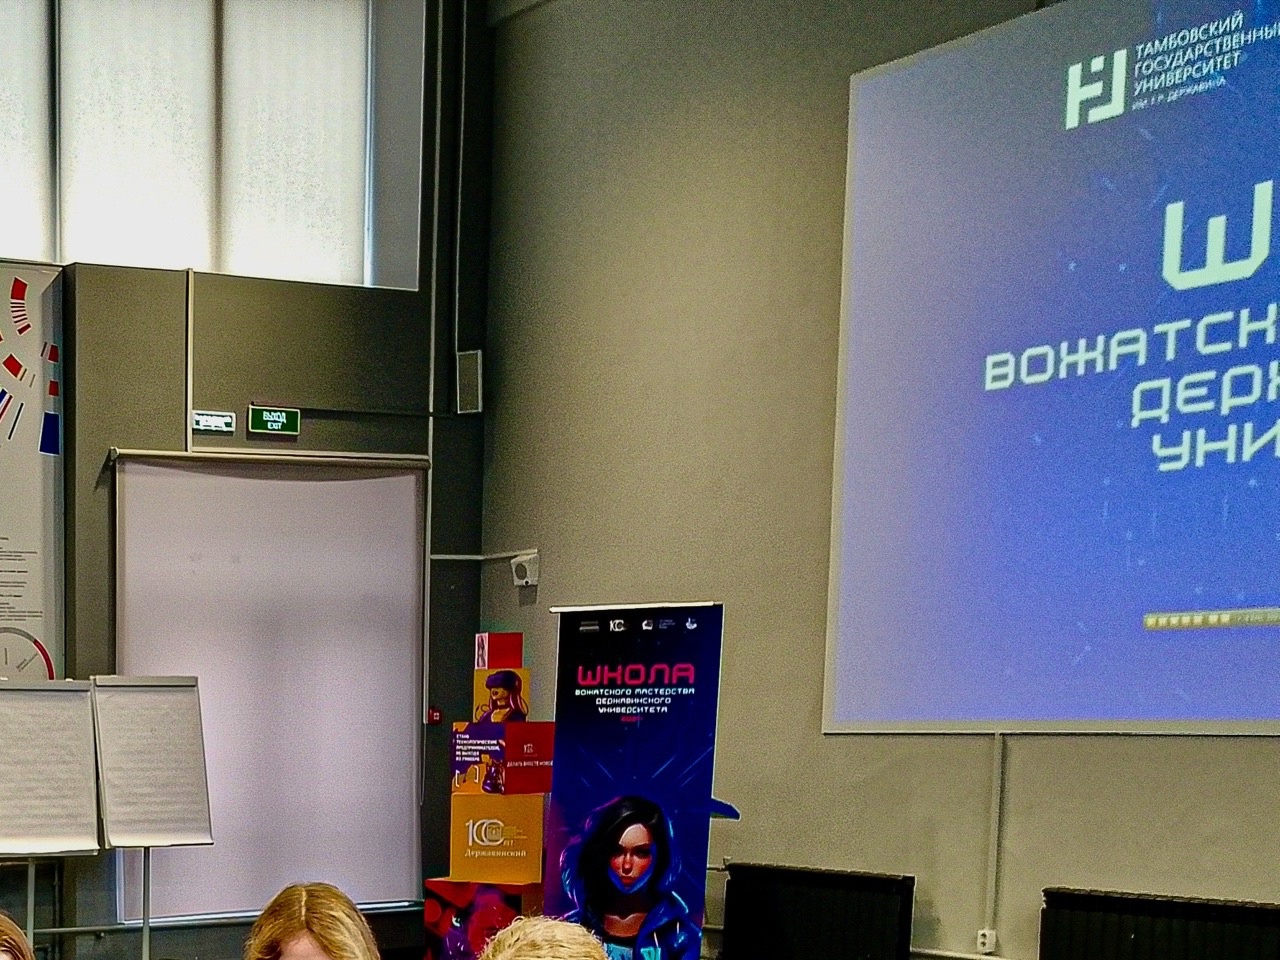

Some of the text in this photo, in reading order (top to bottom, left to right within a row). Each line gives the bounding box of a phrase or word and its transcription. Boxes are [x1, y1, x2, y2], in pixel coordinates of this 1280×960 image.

[1135, 9, 1244, 59] ТАМБОВСКИЙ
[1134, 21, 1280, 77] ГОСУДАРСТВЕННЫ
[1133, 50, 1242, 96] УНИВЕРСИТЕТ
[1162, 179, 1273, 291] Ш
[263, 411, 286, 423] ВЫХОД
[267, 422, 283, 430] EXIT
[1152, 418, 1280, 472] УНИ
[577, 663, 696, 686] ШКОЛА
[575, 688, 695, 696] ВОЖАТСКОГО МАСТЕРСТВА
[595, 697, 672, 705] ДЕРЖАВИНСКОГО
[598, 706, 668, 714] УНИВЕРСИТЕТА
